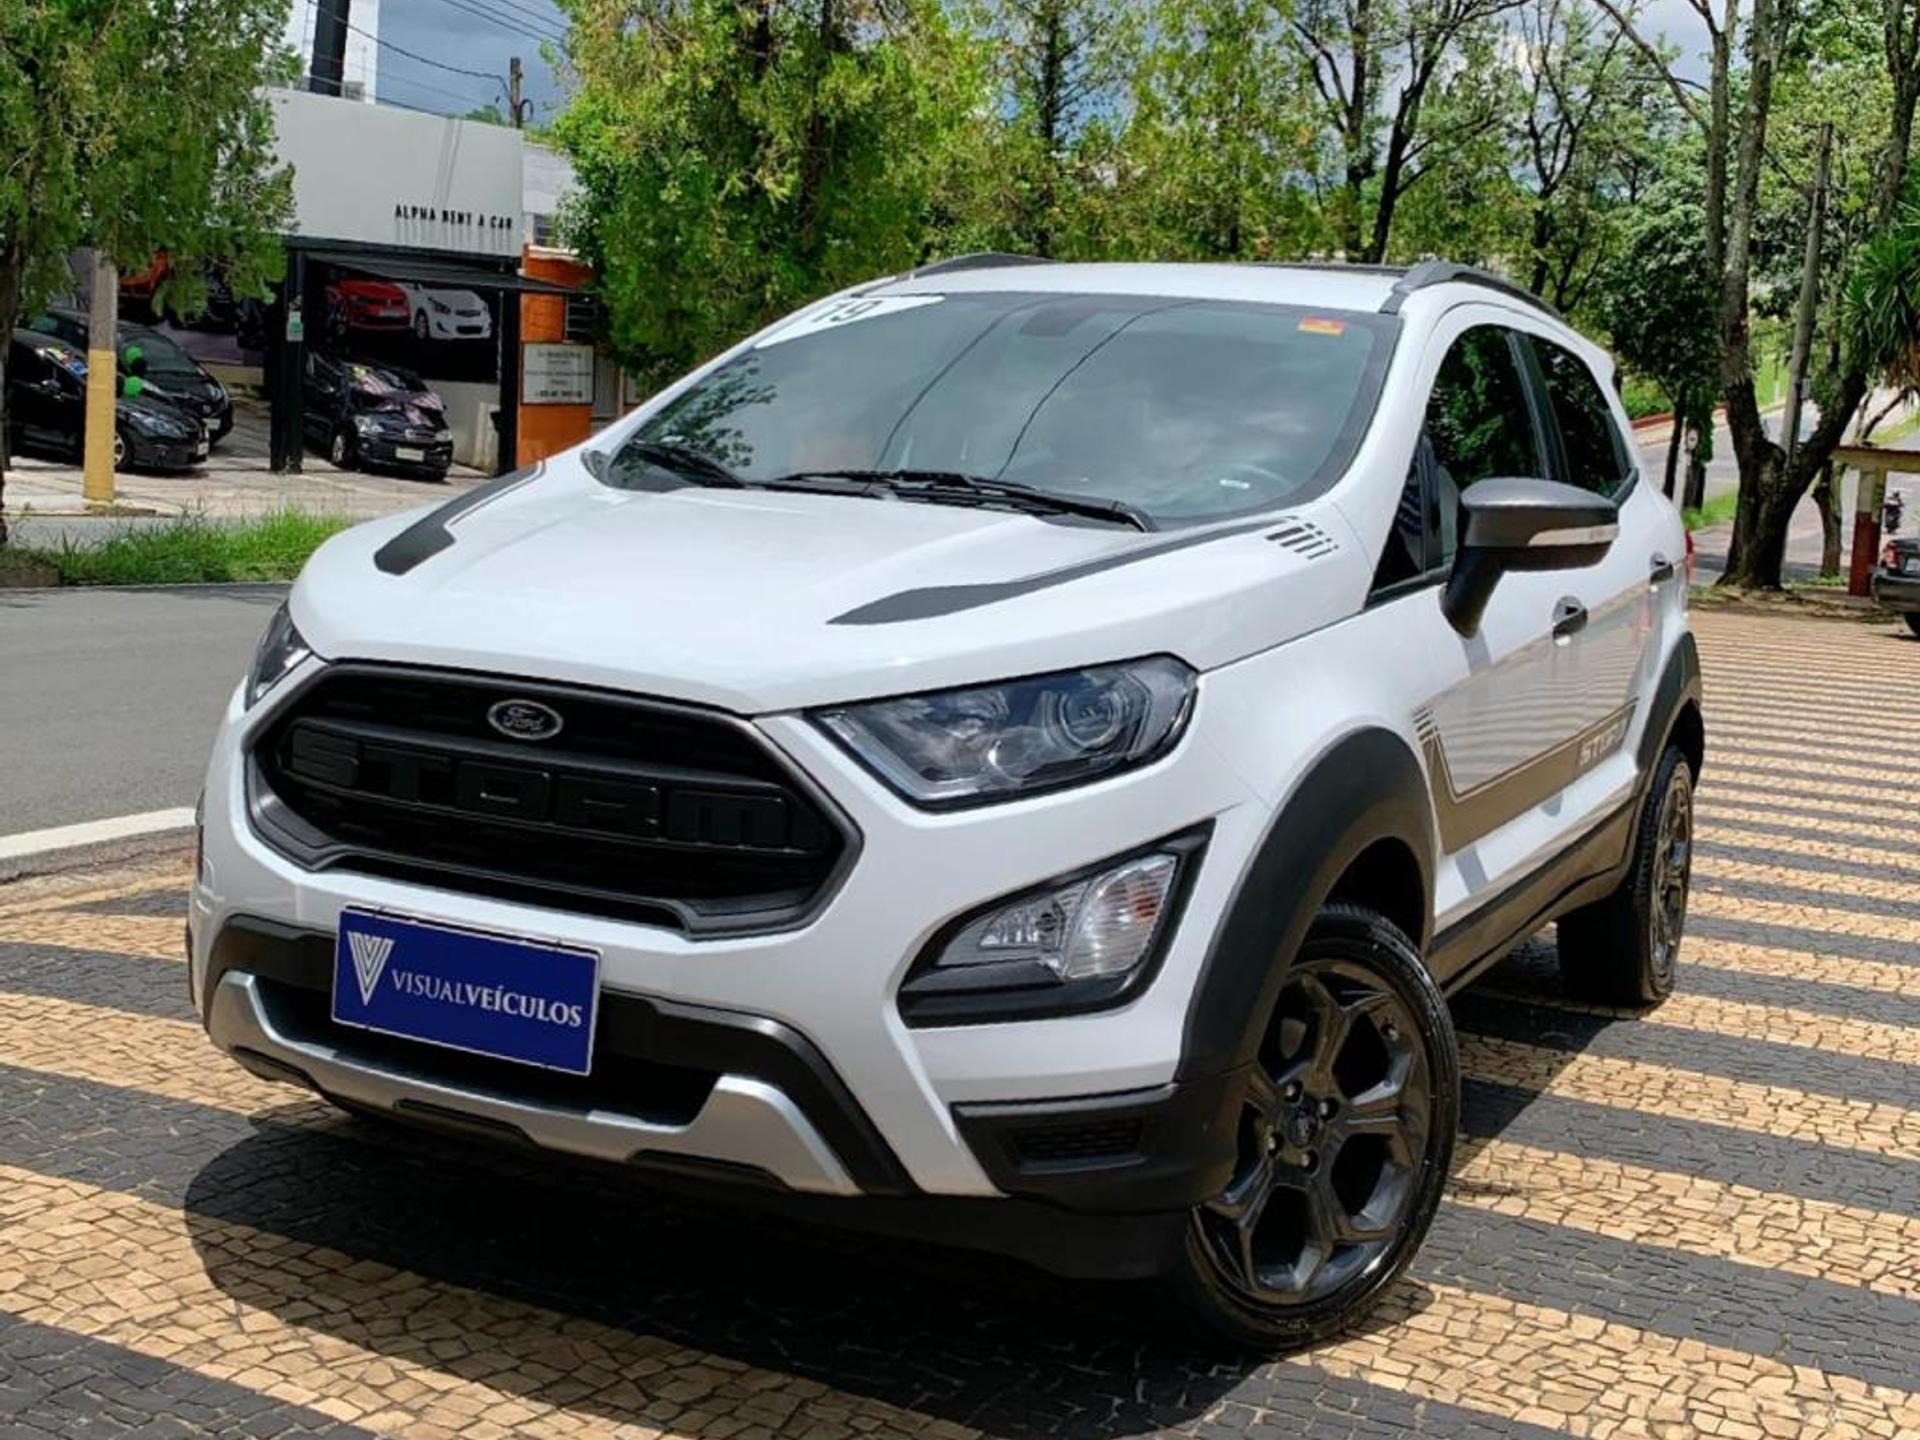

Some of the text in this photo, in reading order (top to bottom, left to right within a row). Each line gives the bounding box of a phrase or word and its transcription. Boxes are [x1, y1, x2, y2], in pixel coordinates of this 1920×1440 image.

[395, 204, 512, 229] ALPHA RENT A CAR
[291, 726, 792, 845] STORM
